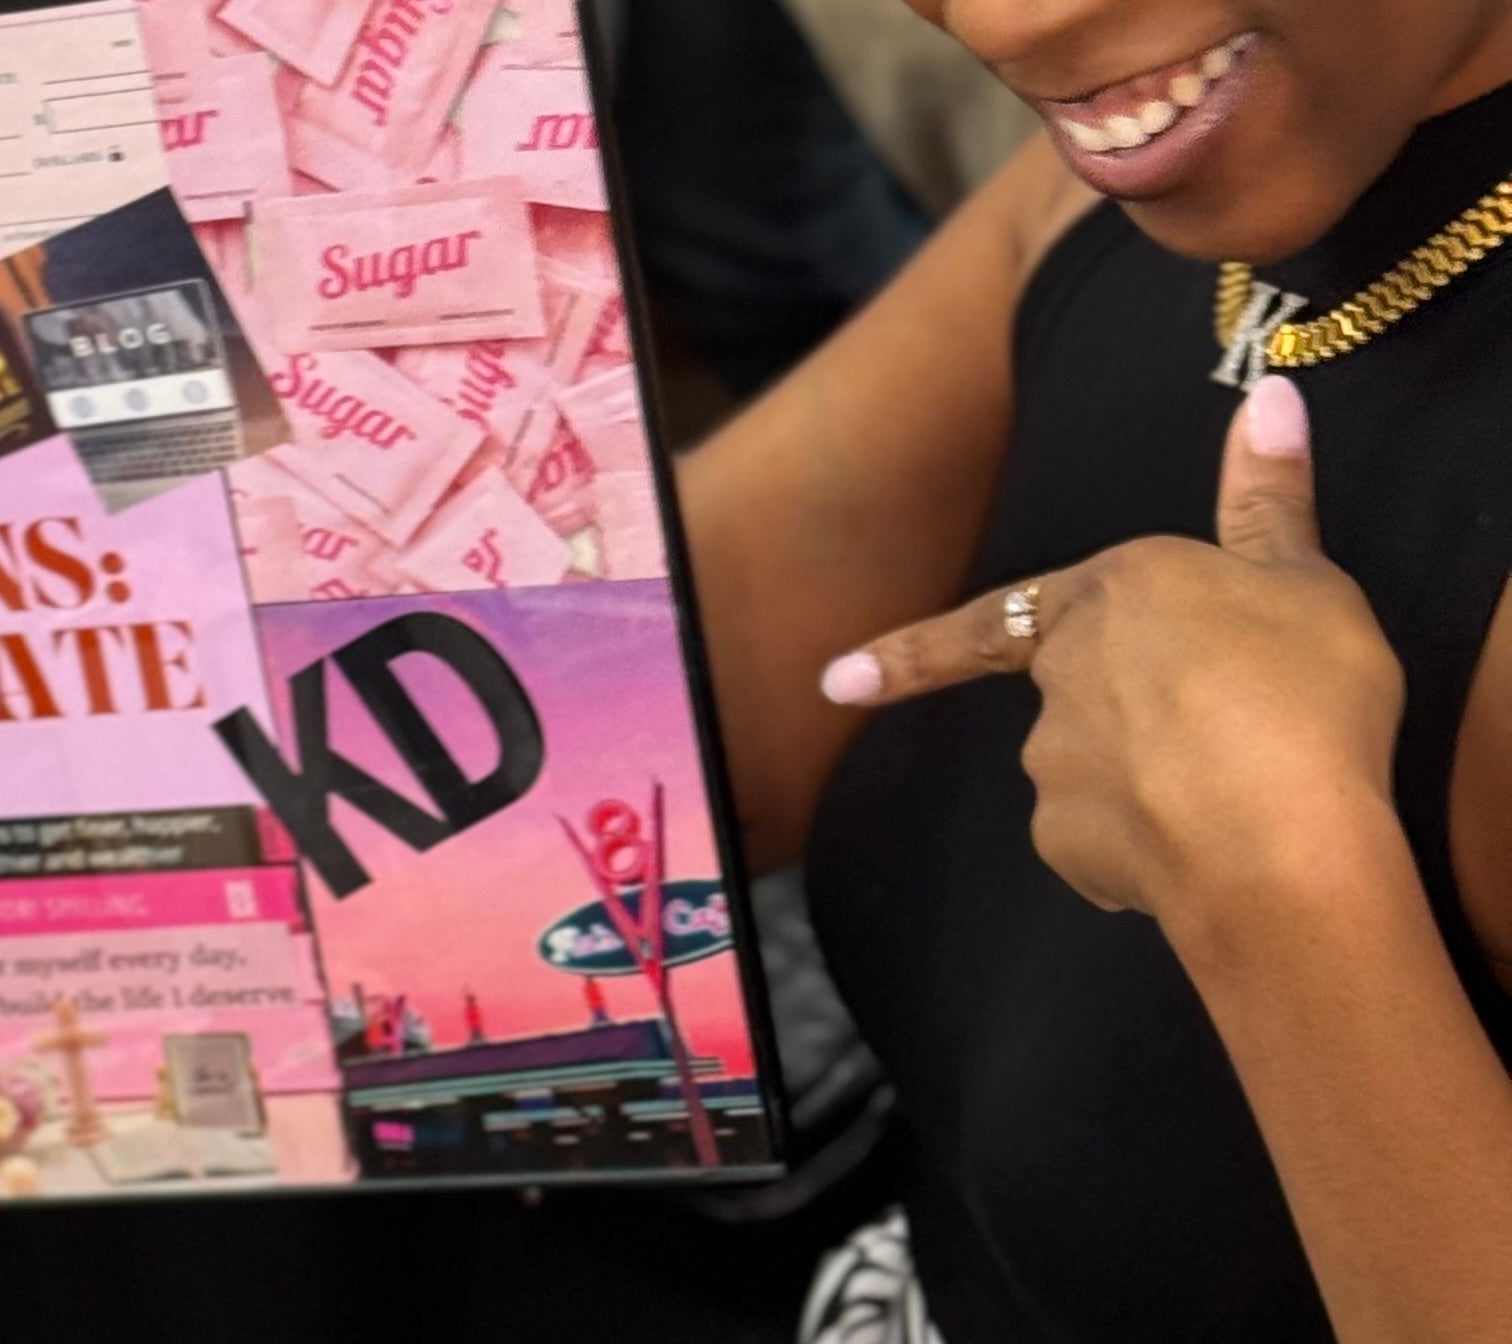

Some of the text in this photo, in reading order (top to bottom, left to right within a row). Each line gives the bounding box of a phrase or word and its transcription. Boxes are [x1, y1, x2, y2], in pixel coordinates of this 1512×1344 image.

[316, 229, 484, 299] Sugar
[69, 323, 172, 357] BLOG
[270, 354, 417, 449] Sugar
[211, 611, 546, 901] KD
[15, 947, 103, 980] myself
[109, 950, 181, 974] every
[190, 943, 249, 970] day,
[73, 989, 115, 1013] the
[121, 985, 164, 1009] life
[190, 980, 296, 1007] deserve
